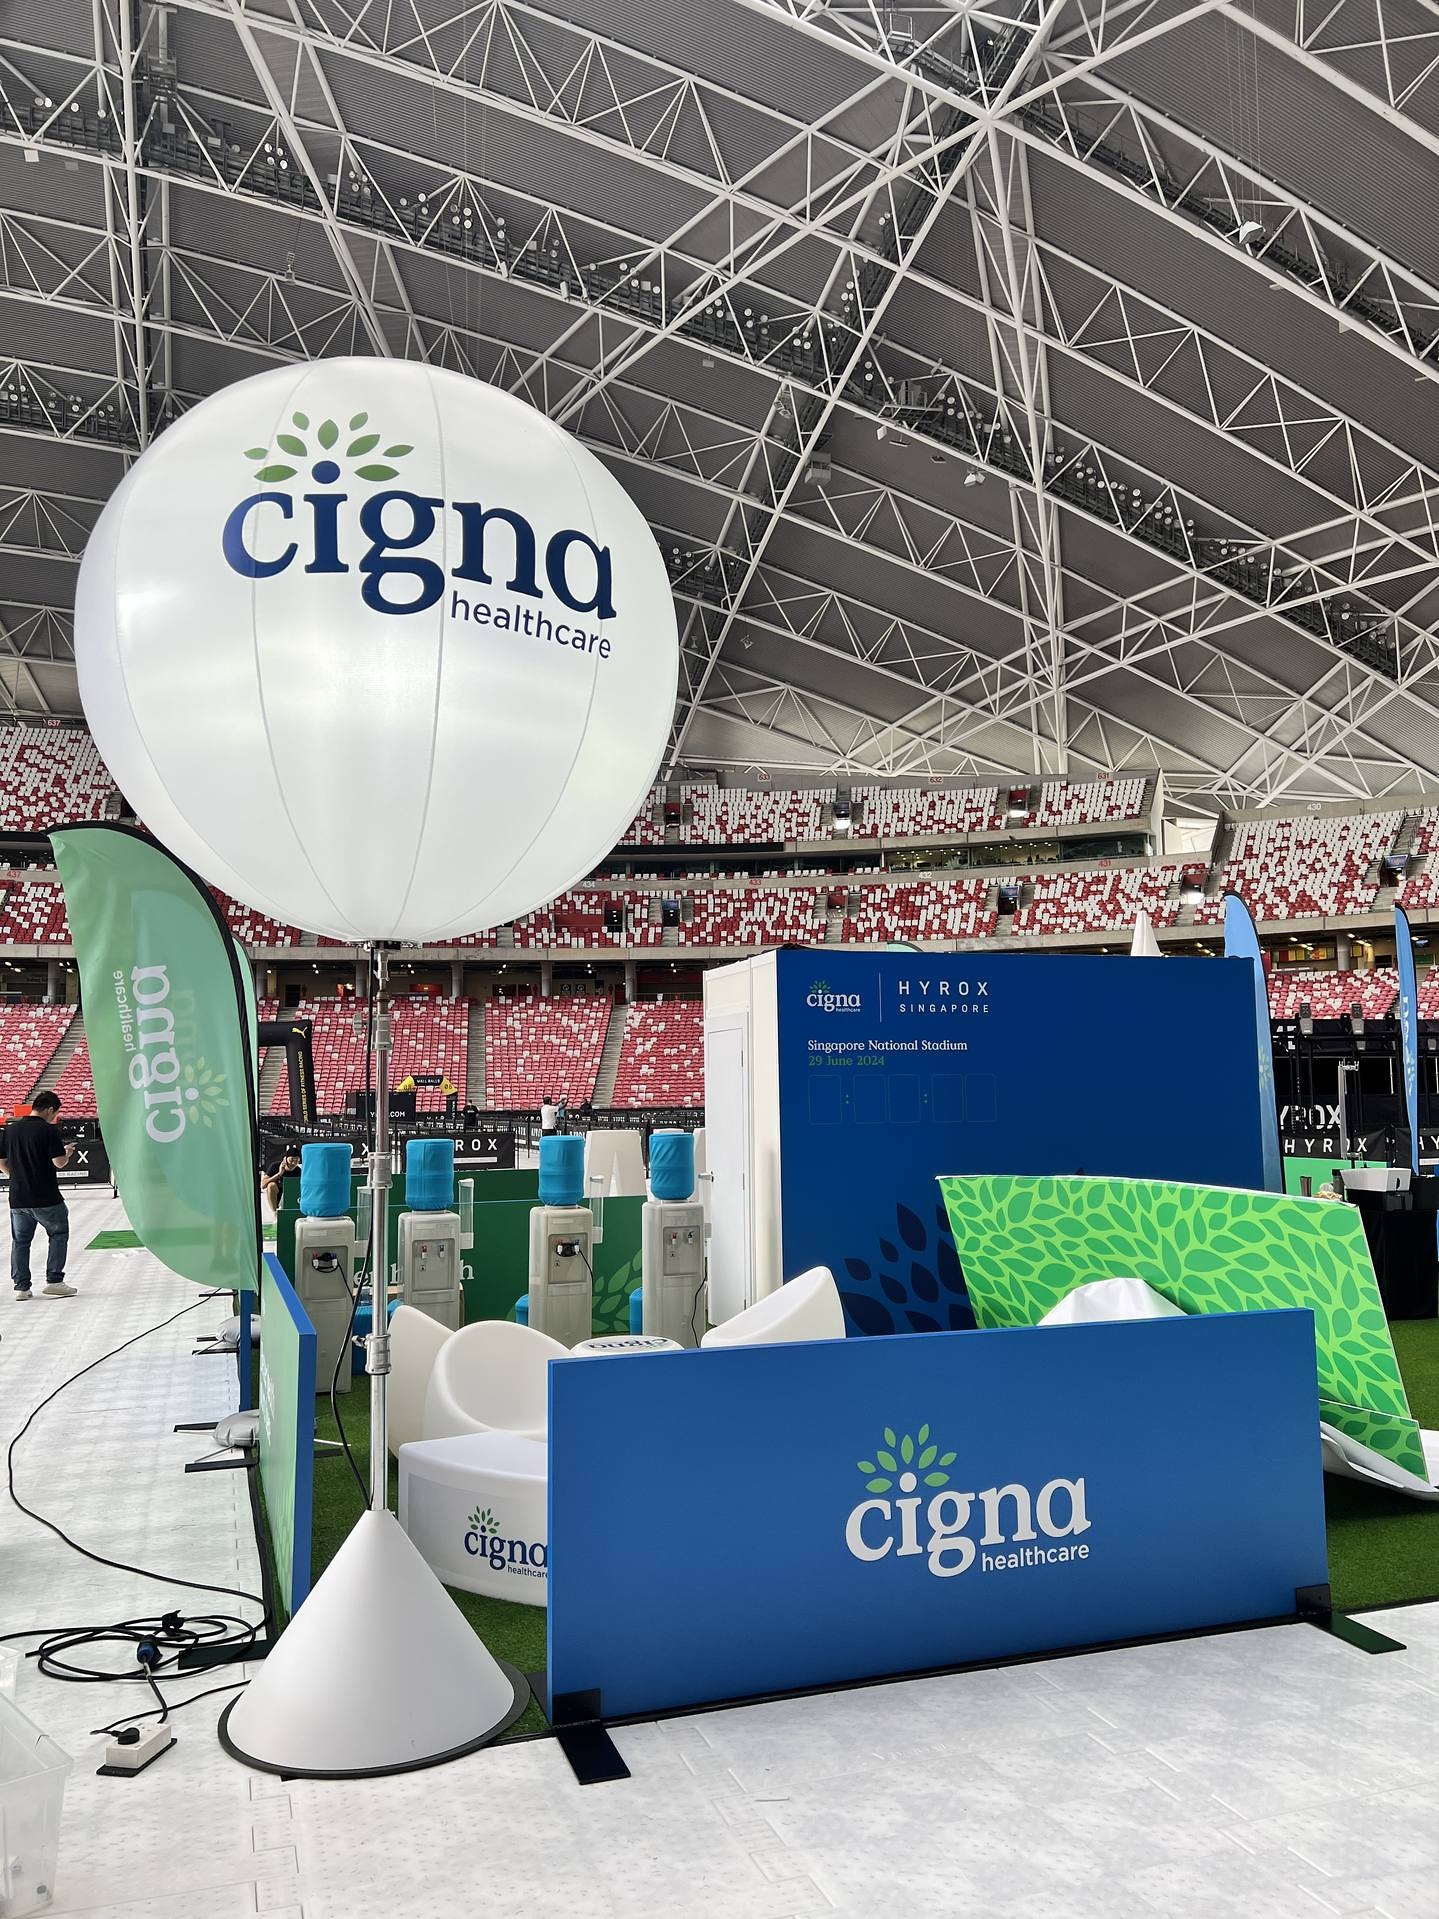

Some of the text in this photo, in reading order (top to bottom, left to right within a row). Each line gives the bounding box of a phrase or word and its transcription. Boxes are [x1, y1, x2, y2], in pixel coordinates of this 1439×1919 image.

[222, 460, 617, 619] cigna
[452, 590, 612, 659] healthcare
[1307, 803, 1322, 811] 430
[898, 981, 989, 996] HYROX
[806, 989, 861, 1013] cigna
[899, 1004, 989, 1013] SINGAPORE
[807, 1039, 968, 1053] Singapore National Stadium
[808, 1056, 885, 1066] 29 June 2024
[455, 1138, 498, 1152] ROX
[845, 1472, 1091, 1577] cigna
[464, 1525, 547, 1570] cigna
[982, 1544, 1090, 1572] healthcare
[507, 1565, 547, 1578] healthcar
